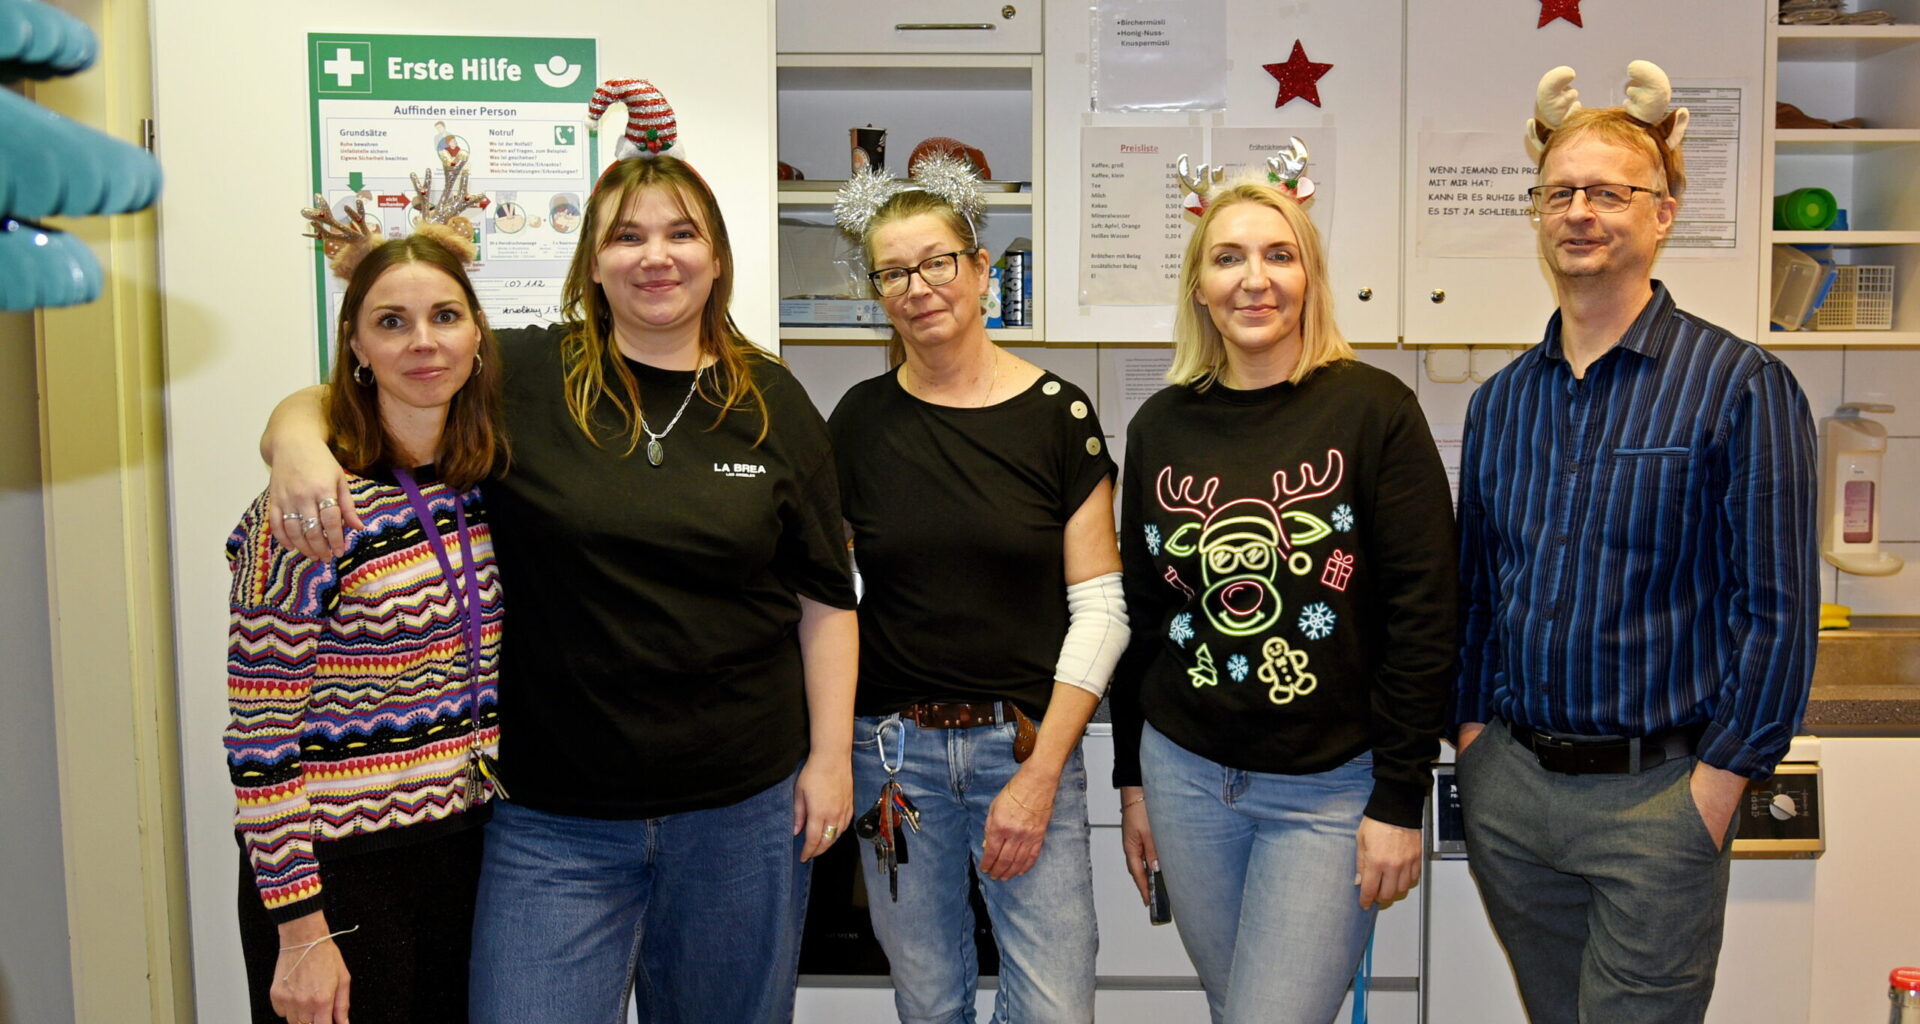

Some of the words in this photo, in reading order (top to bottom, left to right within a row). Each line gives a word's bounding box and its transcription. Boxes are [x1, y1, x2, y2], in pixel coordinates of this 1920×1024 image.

[388, 56, 454, 80] Erste
[462, 58, 522, 82] Hilfe
[394, 105, 446, 116] Auffinden
[449, 106, 477, 116] einer
[480, 107, 517, 117] Person
[340, 128, 388, 137] Grundsätze
[488, 128, 514, 136] Notruf
[1120, 144, 1159, 152] Preisliste
[1428, 166, 1457, 174] WENN
[1460, 166, 1498, 175] JEMAND
[524, 280, 546, 288] 112
[1006, 254, 1022, 320] STRONG
[714, 463, 730, 472] LA
[734, 463, 766, 474] BREA
